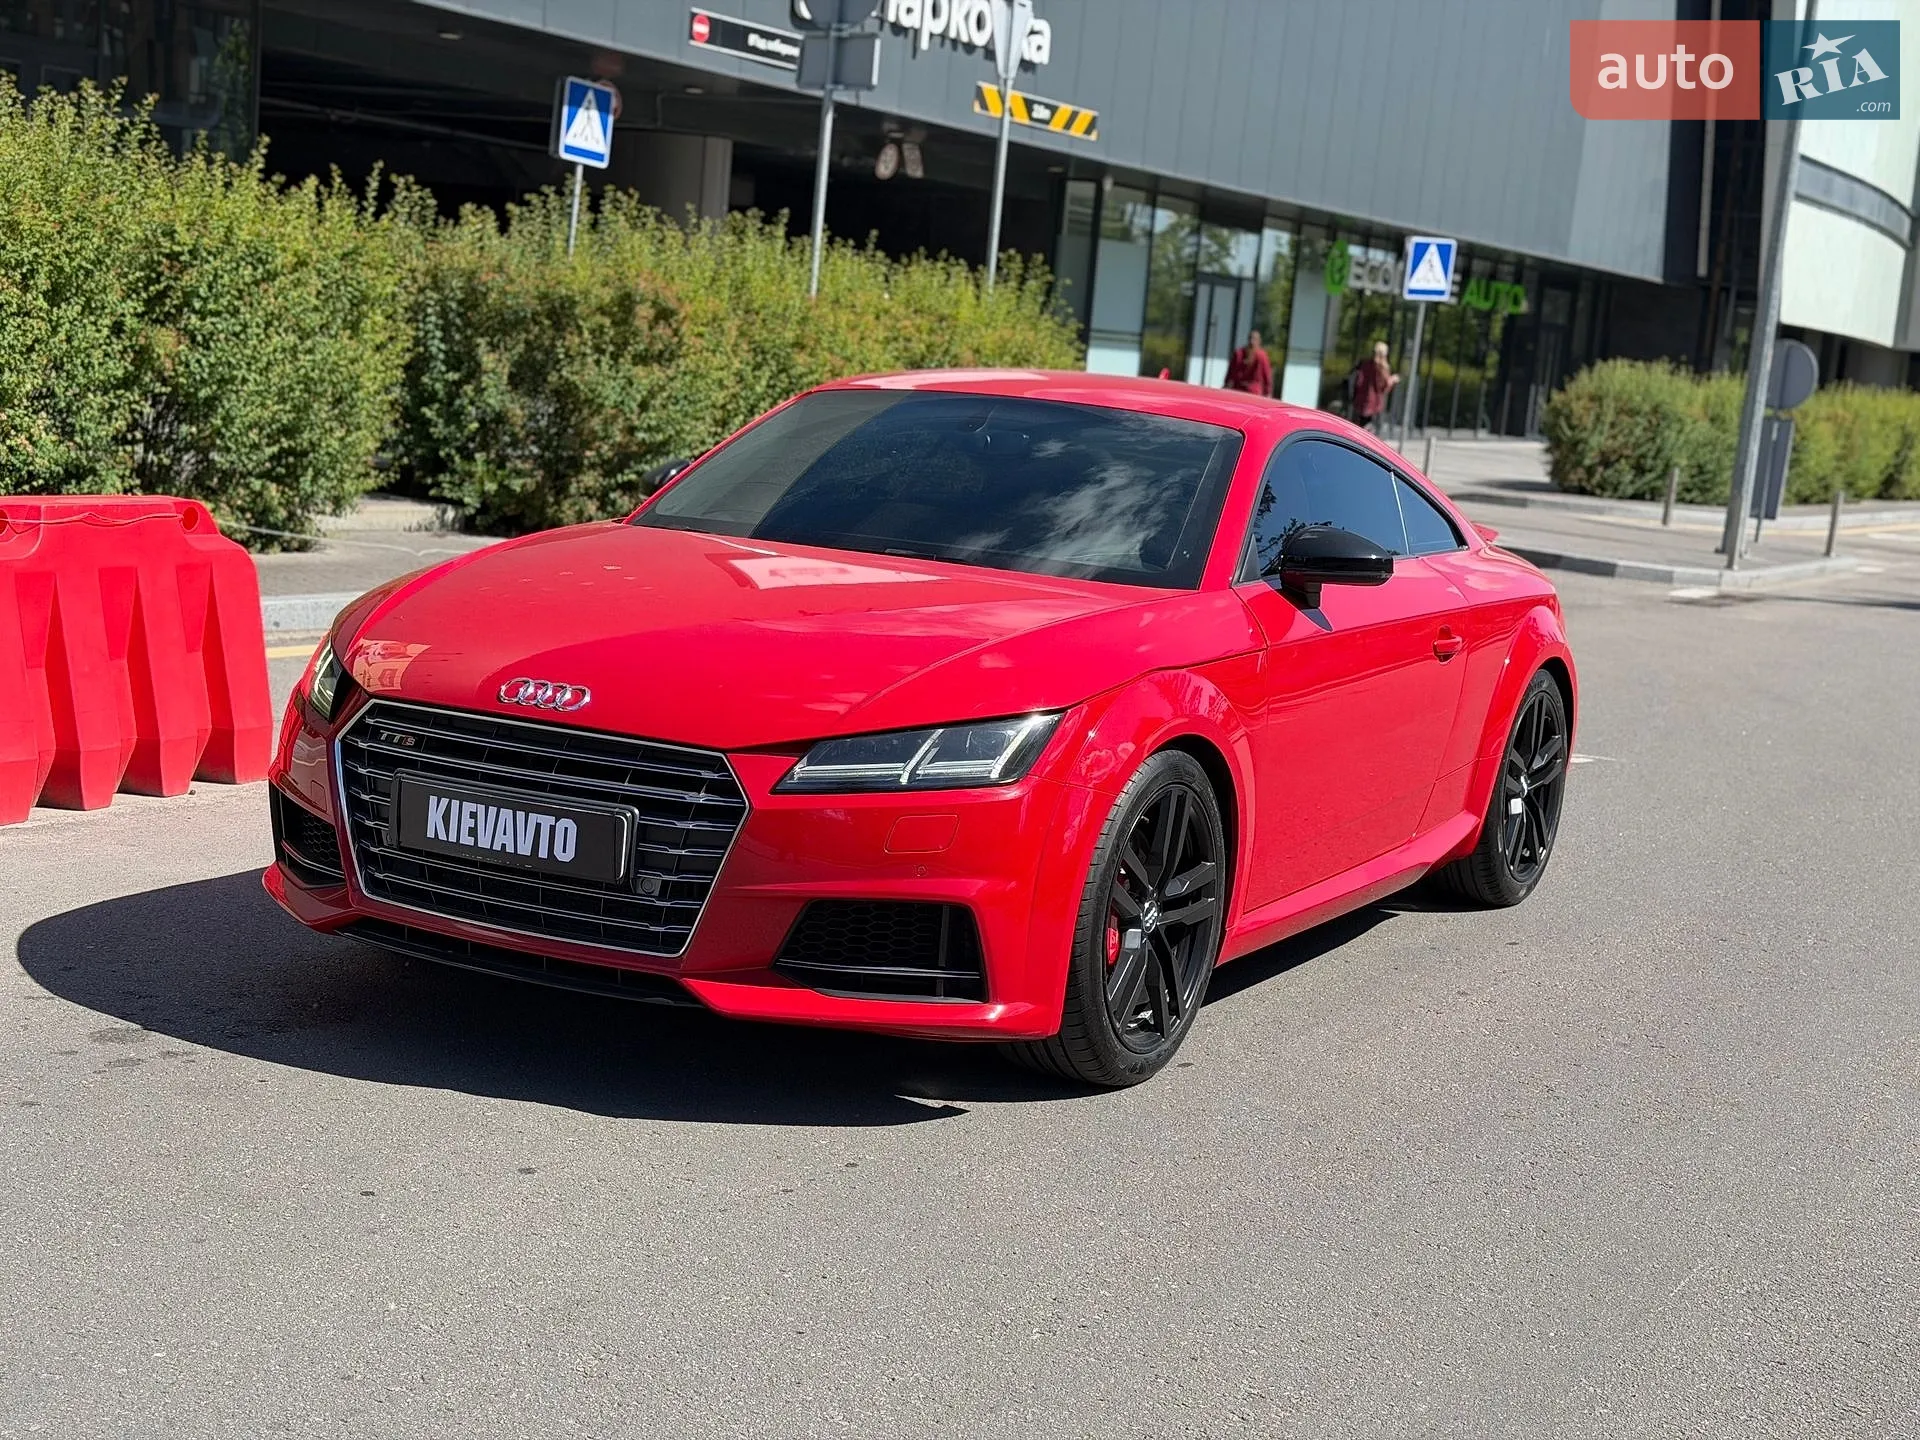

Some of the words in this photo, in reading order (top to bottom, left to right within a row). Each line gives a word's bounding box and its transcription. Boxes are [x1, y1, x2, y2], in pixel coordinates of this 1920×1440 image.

[1463, 278, 1526, 314] AUTO
[380, 730, 415, 746] TTS
[426, 795, 577, 863] KIEVAVTO
